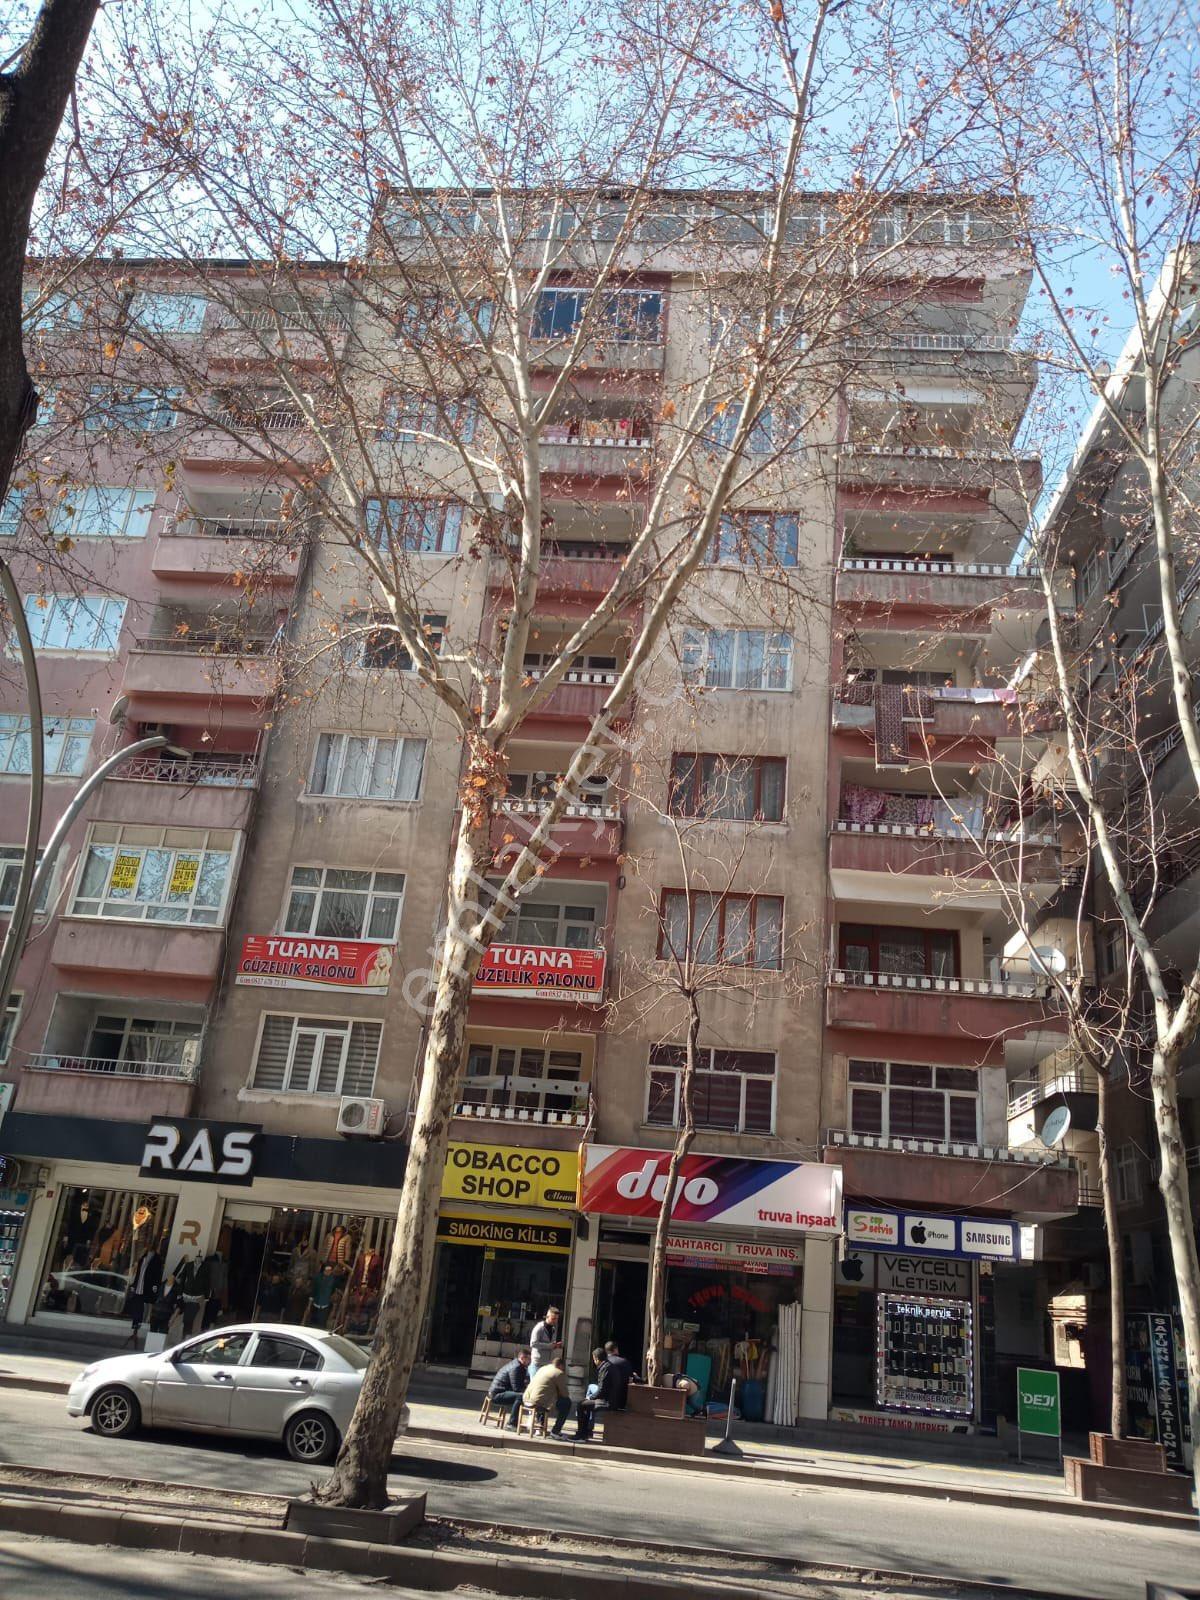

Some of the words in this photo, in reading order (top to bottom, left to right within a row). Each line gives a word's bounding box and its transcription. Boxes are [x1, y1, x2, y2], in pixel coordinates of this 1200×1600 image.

[266, 940, 340, 960] TUANA
[490, 947, 573, 969] TUANA
[243, 956, 302, 975] GÜZELLİK
[305, 964, 357, 979] SALONU
[475, 965, 532, 984] ÜZELLİK
[538, 972, 595, 988] SALONU
[141, 1125, 256, 1175] RAS
[444, 1148, 560, 1176] TOBACCO
[461, 1175, 531, 1198] SHOP
[617, 1160, 719, 1215] dyo
[758, 1209, 793, 1224] truva
[797, 1210, 837, 1227] inşaat
[178, 1220, 201, 1246] R
[449, 1222, 514, 1240] SMOKİNG
[518, 1227, 557, 1244] KİLLS
[927, 1230, 949, 1240] iPhone
[966, 1232, 1011, 1246] SAMSUNG
[665, 1238, 723, 1251] NAHTARCI
[736, 1244, 773, 1257] TRUVA
[884, 1256, 965, 1278] VEYCELL
[897, 1304, 922, 1316] teknik
